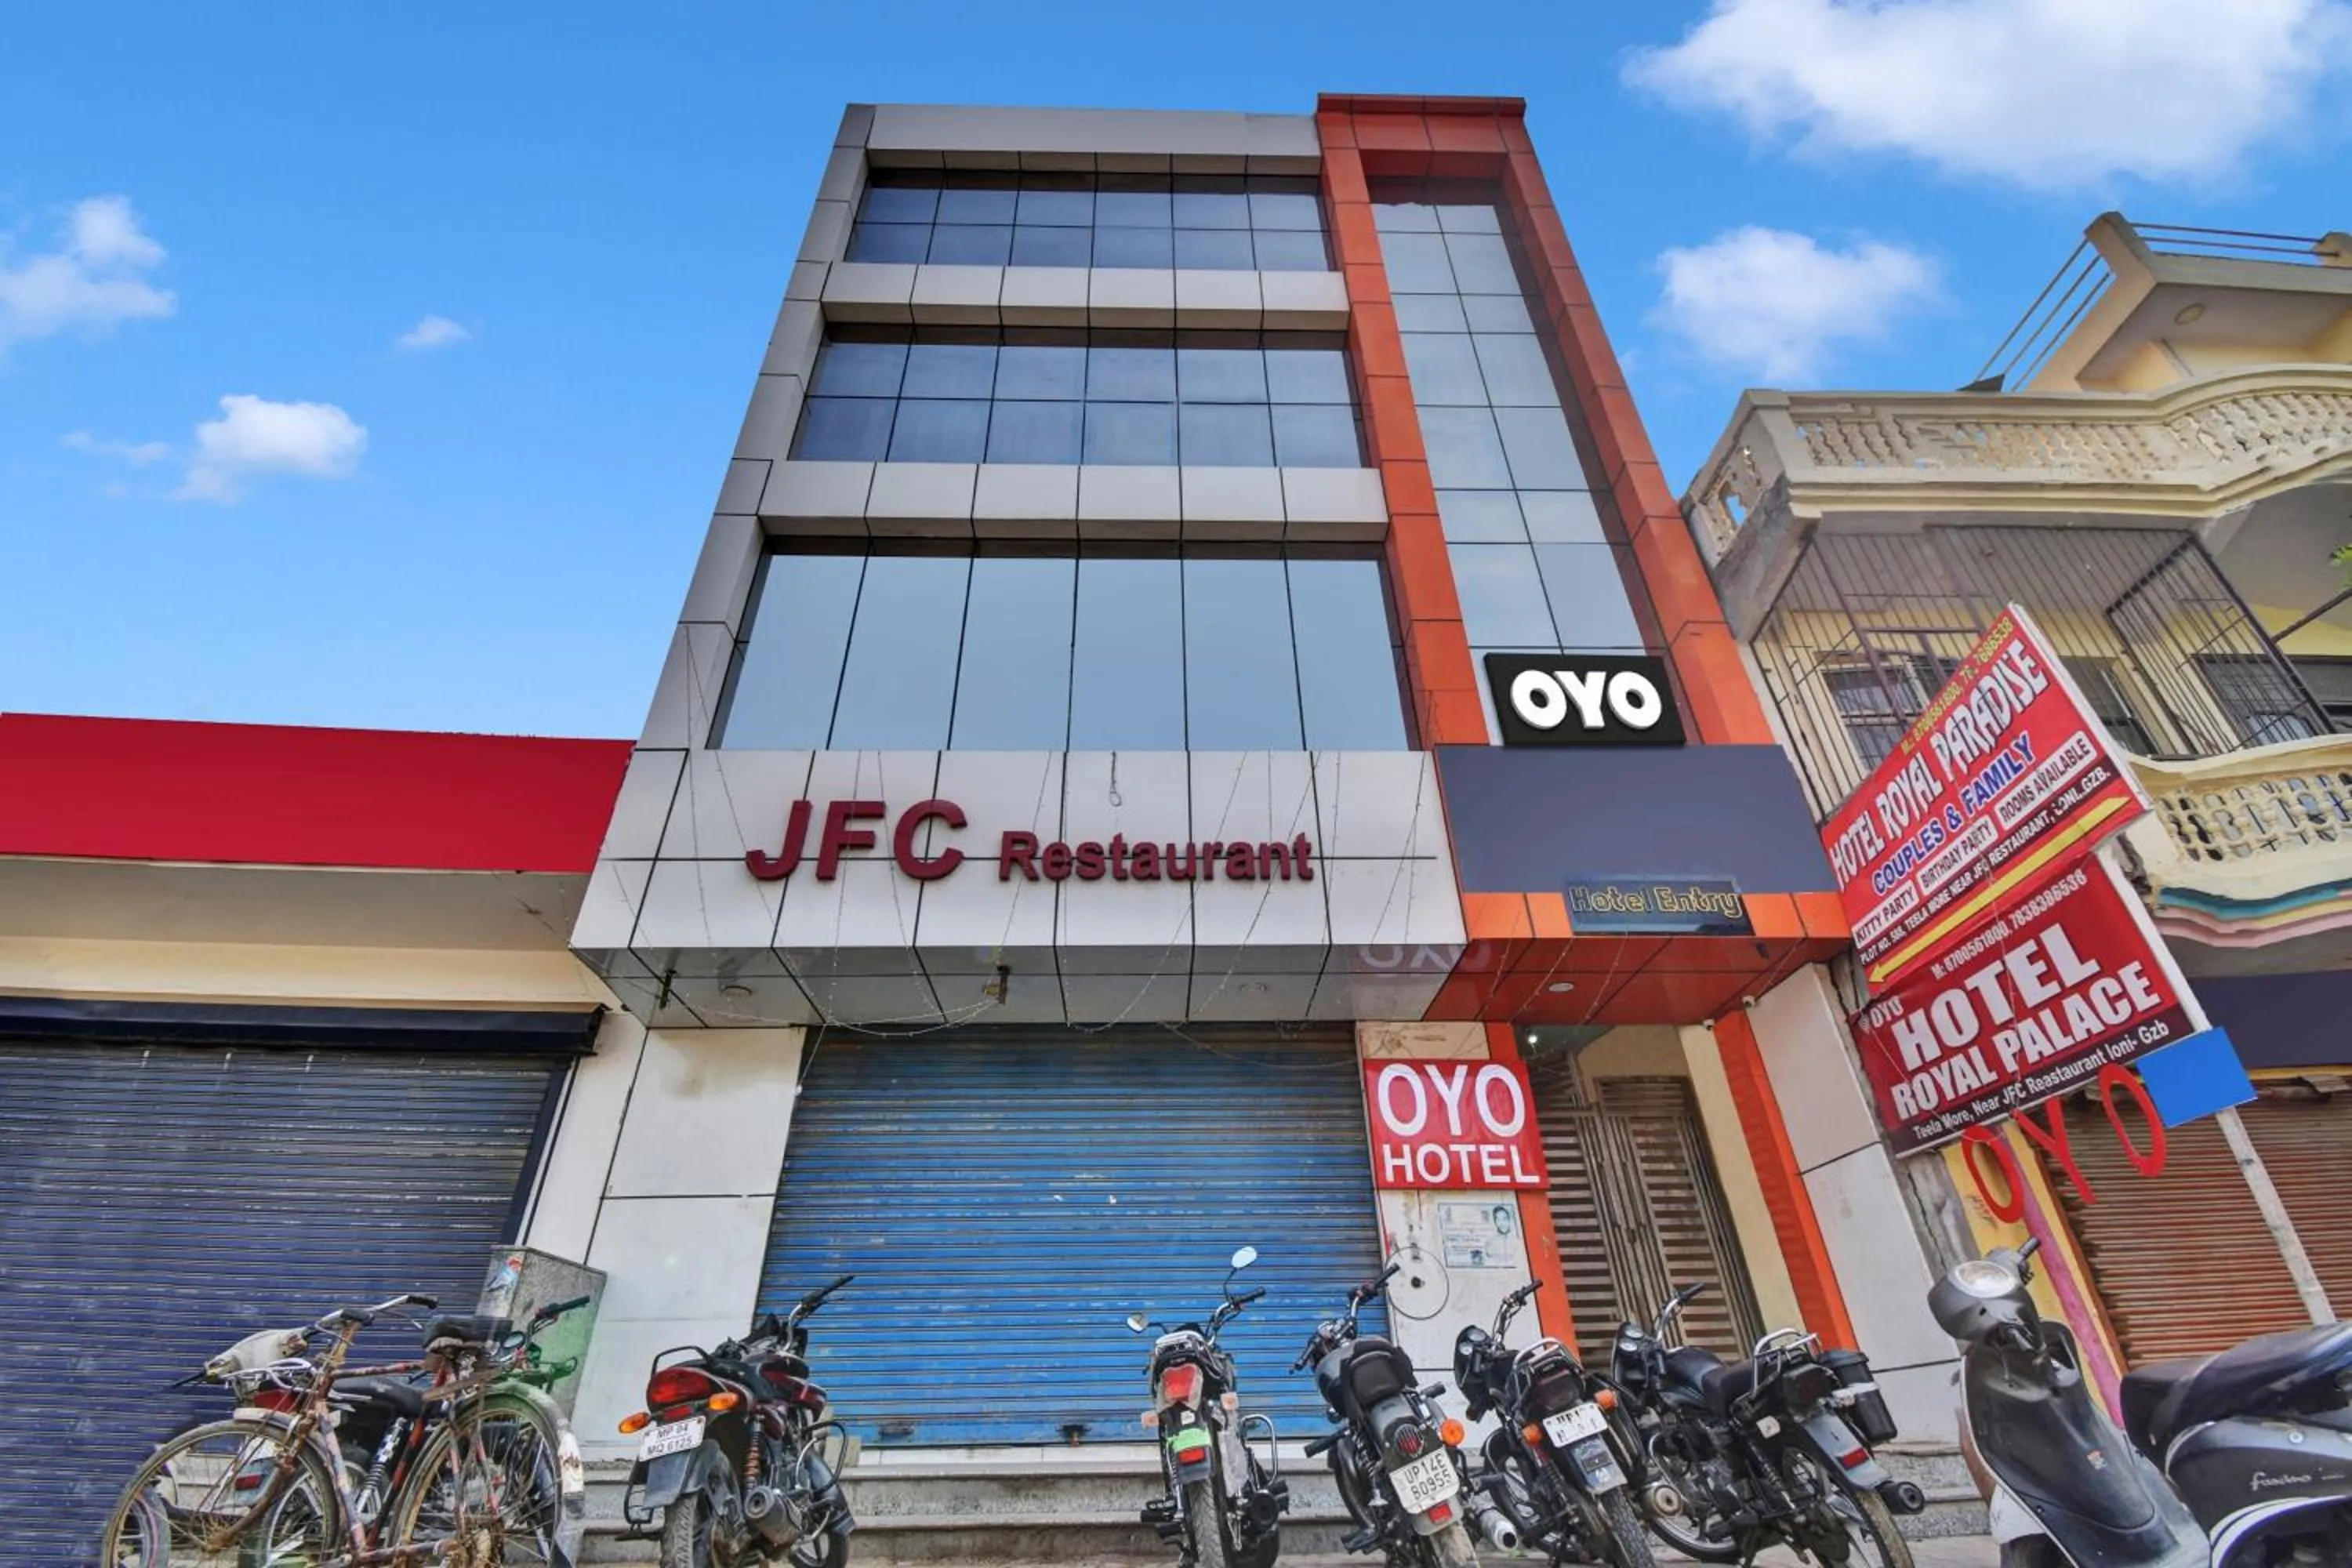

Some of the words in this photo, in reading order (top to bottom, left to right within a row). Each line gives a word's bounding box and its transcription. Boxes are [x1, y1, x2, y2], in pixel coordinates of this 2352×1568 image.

[1509, 669, 1663, 730] OYO
[1831, 815, 1885, 892] HOTEL
[1876, 753, 1944, 840] ROYAL
[1929, 640, 2049, 782] PARADISE
[1999, 785, 2036, 822] ROOMS
[2033, 738, 2090, 795] AVAILABLE
[746, 798, 967, 881] JFC
[1000, 829, 1316, 883] Restaurant
[1872, 815, 1947, 895] COUPLES
[1947, 806, 1962, 830] &
[1959, 731, 2035, 818] FAMILY
[1860, 946, 1880, 966] PLOT
[1927, 889, 1953, 914] MORE
[1949, 872, 1974, 898] NEAR
[1988, 810, 2056, 866] RESTAURANT,
[1921, 846, 1964, 889] BIRTHDAY
[1962, 823, 1992, 860] PARTY
[1569, 886, 1653, 913] Hotel
[1653, 886, 1743, 919] Entry
[1855, 914, 1883, 943] KITTY
[1883, 887, 1915, 922] PARTY
[1870, 996, 1904, 1029] OYO
[1890, 923, 2101, 1072] HOTEL
[1891, 1053, 1998, 1121] ROYAL
[1992, 960, 2161, 1074] PALACE
[1914, 1116, 1943, 1141] Teela
[1973, 1096, 2000, 1120] Near
[2001, 1082, 2026, 1108] JFC
[2025, 1048, 2107, 1096] Reastaurant
[2139, 1020, 2169, 1047] Gzb
[1377, 1063, 1525, 1137] OYO
[1382, 1144, 1540, 1183] HOTEL
[1961, 1063, 2168, 1225] OYO
